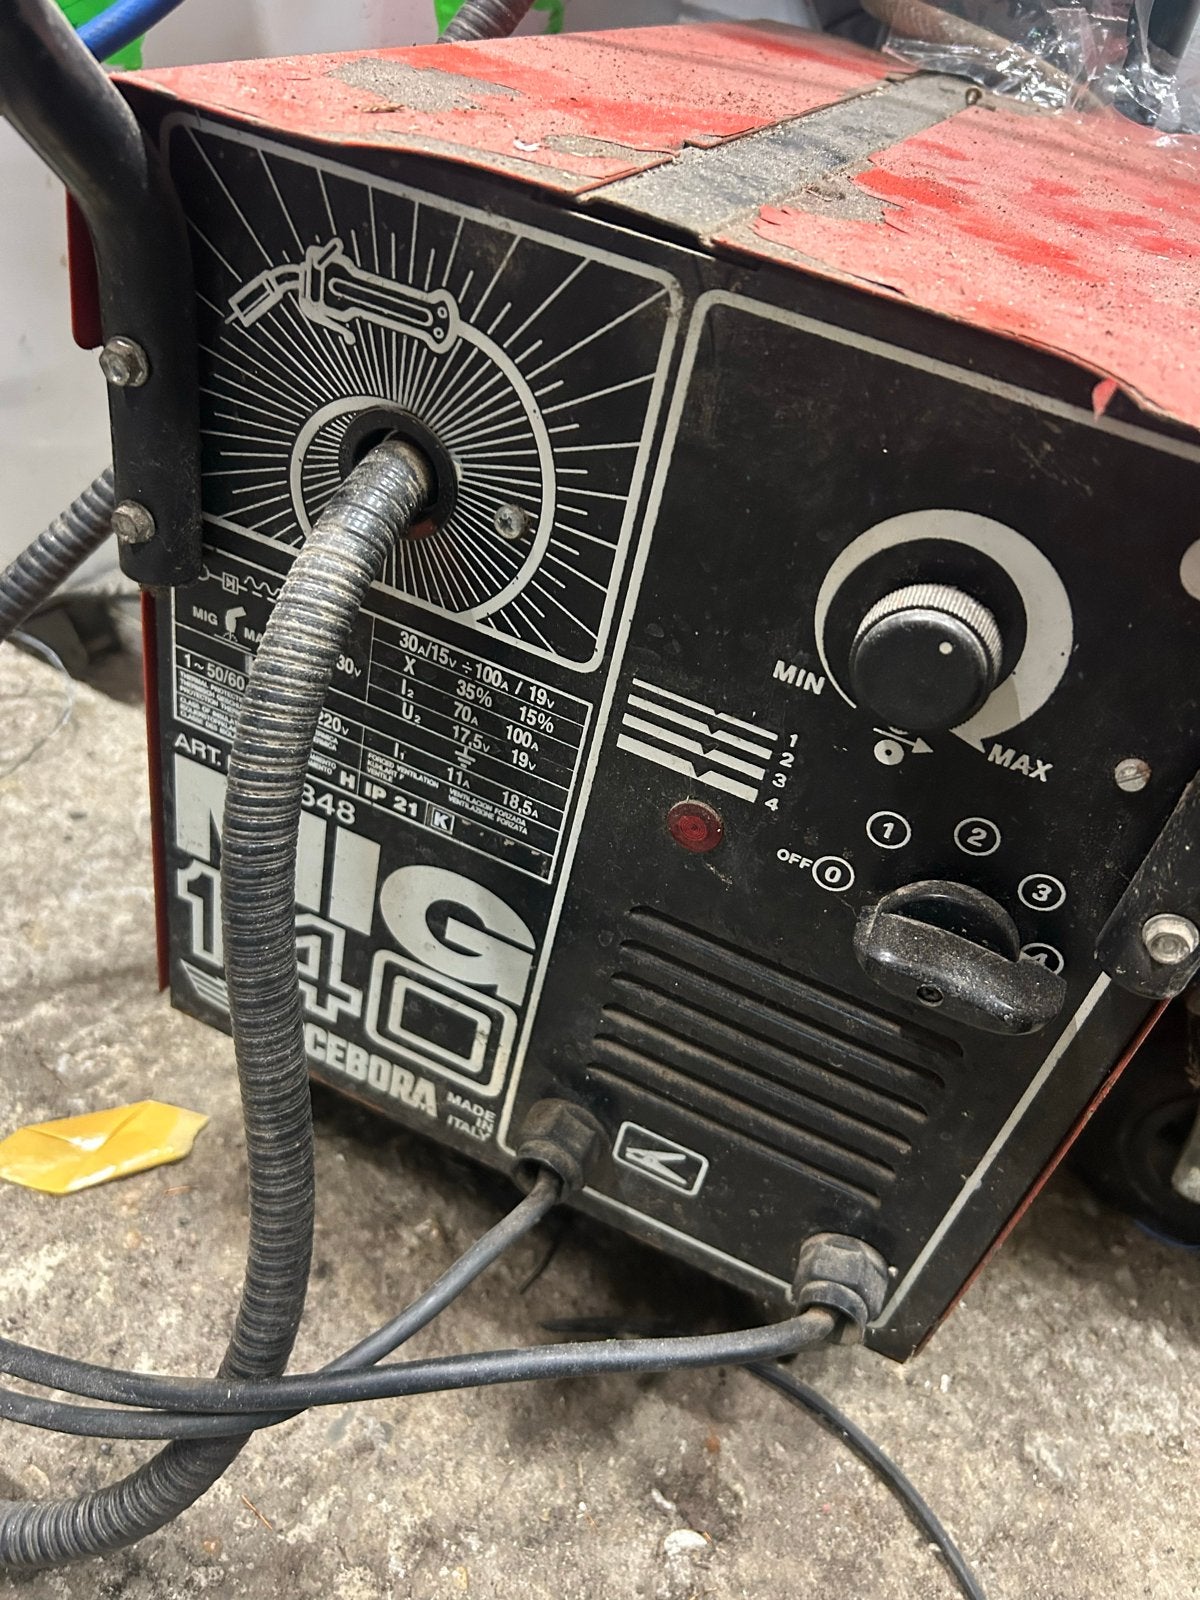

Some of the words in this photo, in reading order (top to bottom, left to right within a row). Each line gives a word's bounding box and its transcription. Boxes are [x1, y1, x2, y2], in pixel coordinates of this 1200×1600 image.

[193, 606, 219, 626] MIG
[772, 660, 826, 695] MIN
[403, 655, 416, 675] X
[457, 679, 492, 708] 35%
[520, 706, 554, 733] 15%
[174, 732, 222, 767] ART.
[789, 733, 799, 748] 1
[779, 751, 795, 768] 2
[987, 743, 1053, 782] MAX
[339, 769, 356, 790] H
[772, 772, 787, 788] 3
[364, 780, 387, 800] IP
[393, 795, 418, 818] 21
[764, 797, 779, 811] 4
[433, 810, 449, 830] K
[882, 822, 895, 840] 1
[966, 827, 988, 847] 2
[776, 848, 813, 869] OFF
[1031, 883, 1053, 902] 3
[305, 1022, 438, 1118] CEBORA
[447, 1091, 497, 1123] MADE
[446, 1114, 492, 1141] ITALY
[475, 1117, 494, 1133] IN
